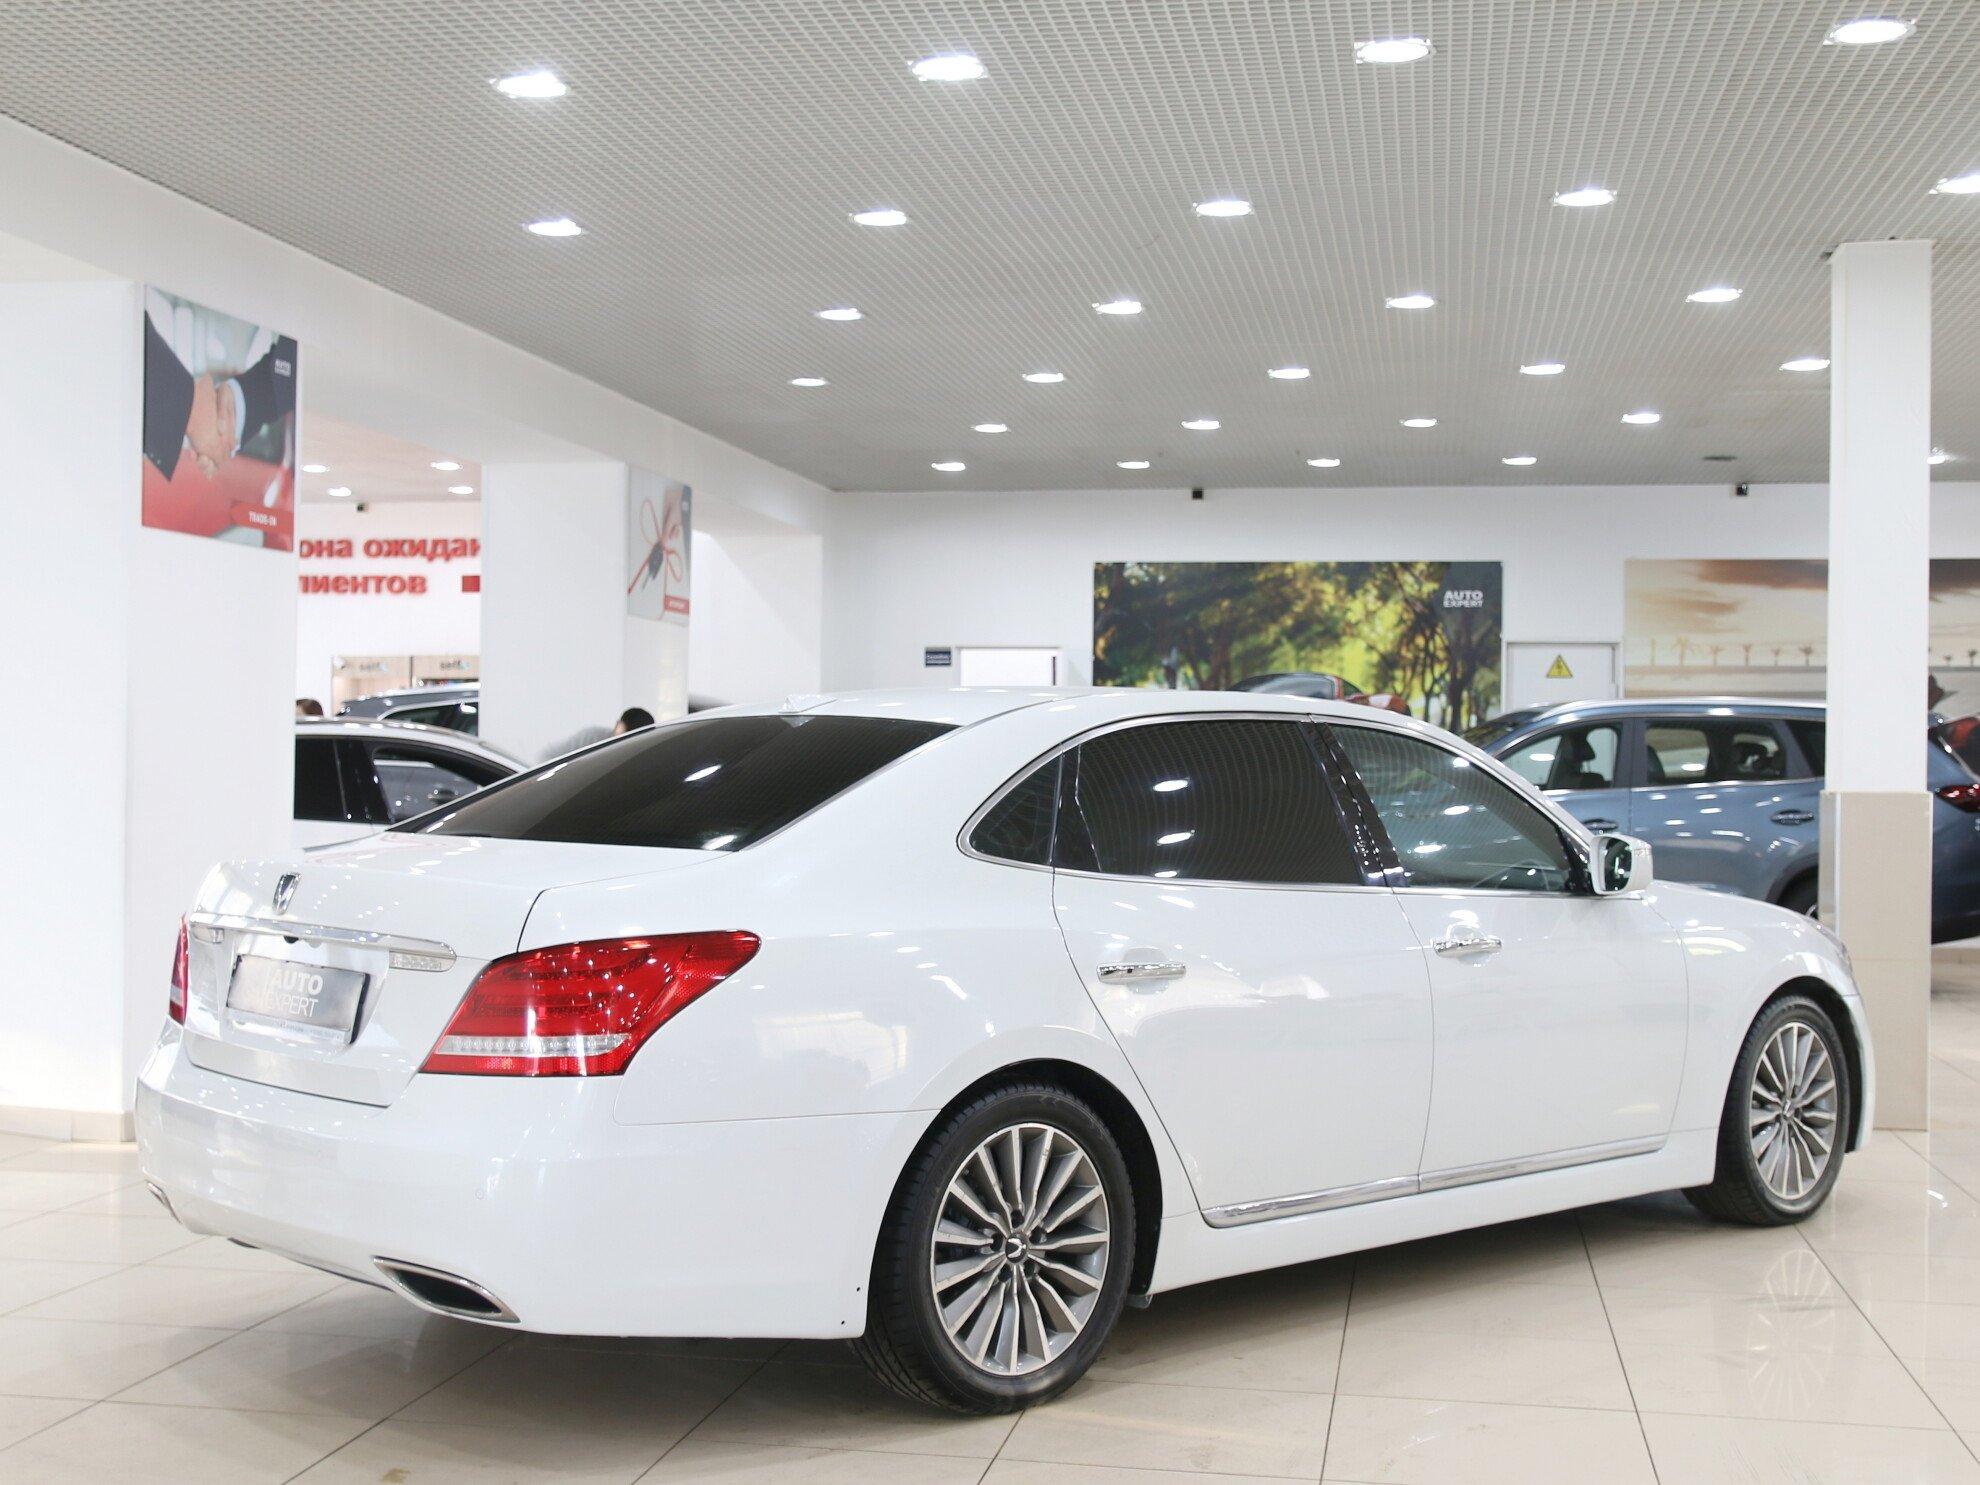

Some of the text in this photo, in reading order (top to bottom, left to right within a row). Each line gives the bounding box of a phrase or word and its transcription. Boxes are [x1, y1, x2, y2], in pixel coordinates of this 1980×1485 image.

[1443, 600, 1483, 608] EXPERT
[1444, 590, 1483, 601] AUTO
[271, 968, 323, 995] AUTO
[265, 990, 319, 1018] EXPERT
